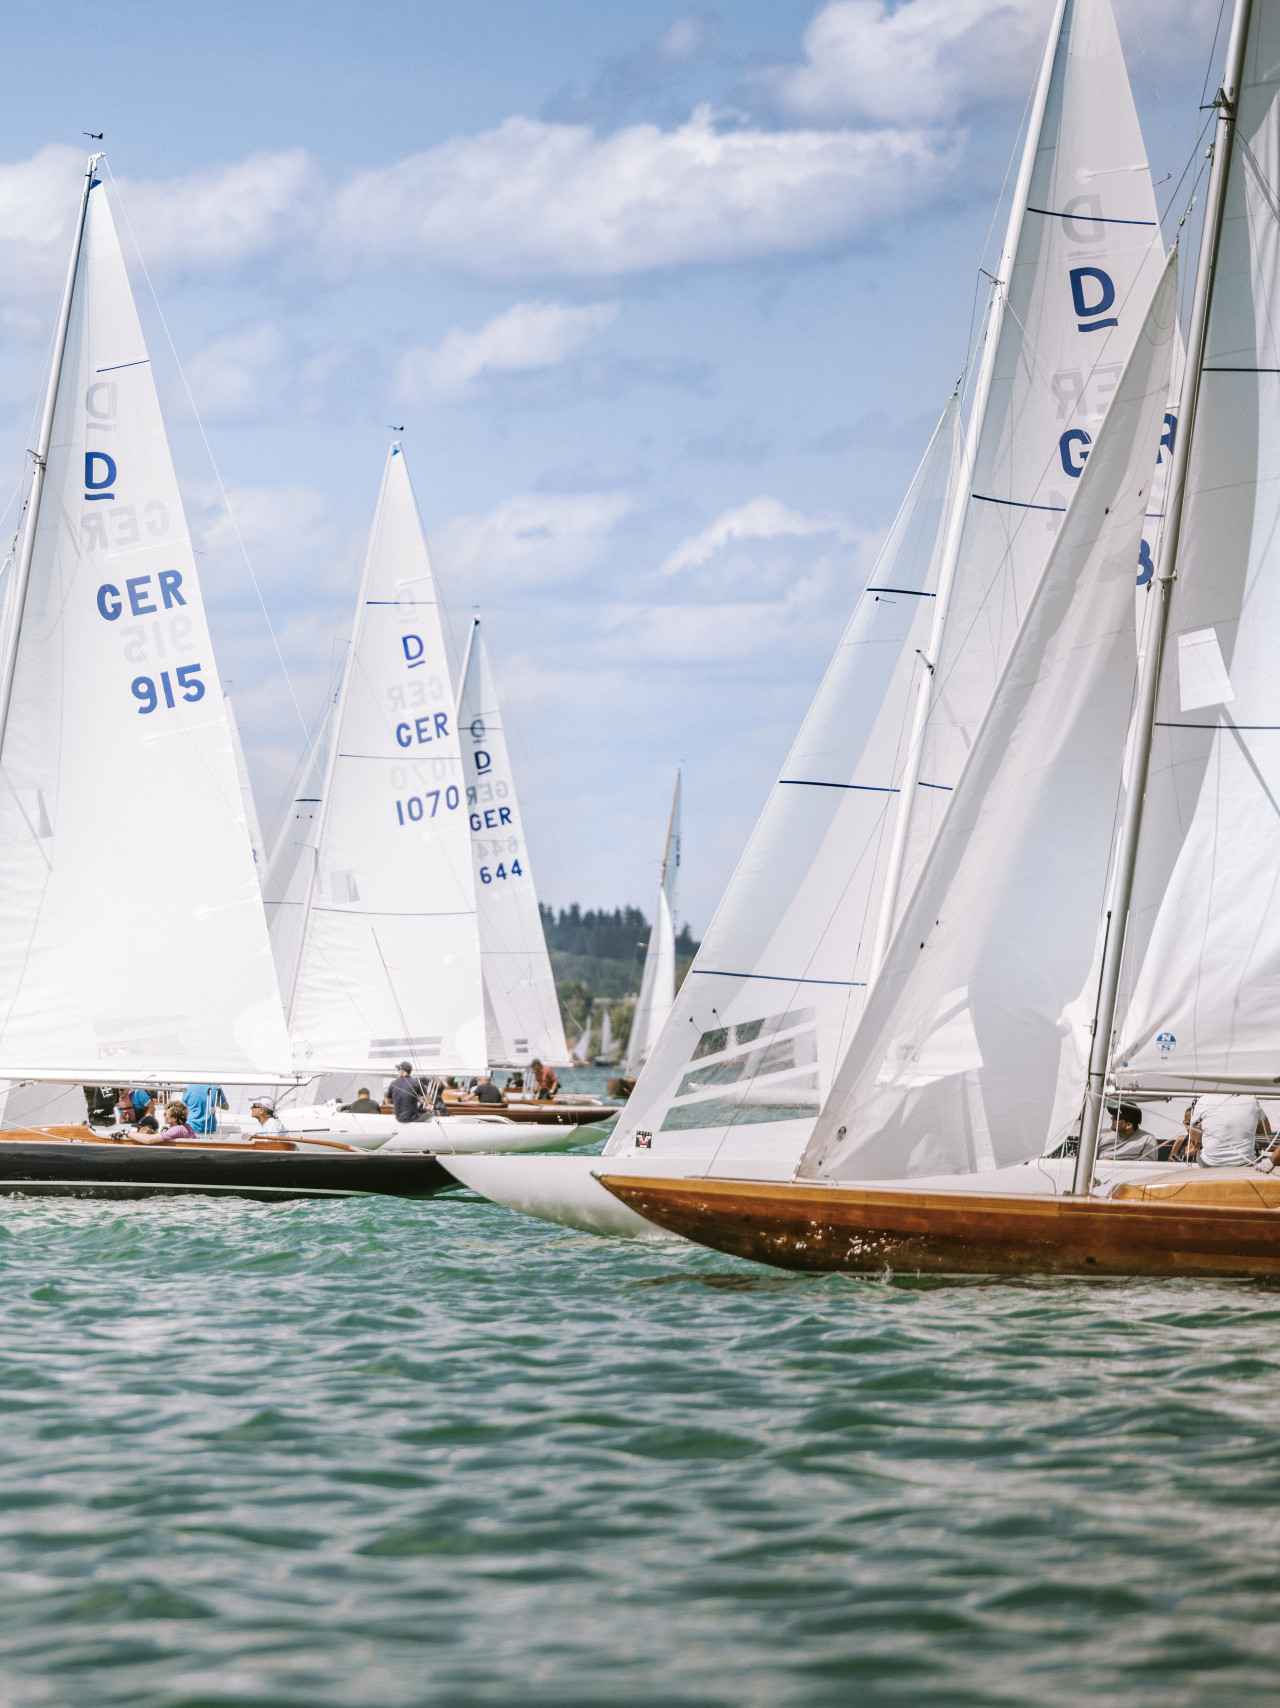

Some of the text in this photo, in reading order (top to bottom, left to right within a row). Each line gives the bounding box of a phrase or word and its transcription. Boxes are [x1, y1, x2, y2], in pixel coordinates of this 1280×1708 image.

[1069, 266, 1118, 333] D
[1059, 413, 1178, 478] GR
[84, 451, 117, 501] D
[97, 569, 187, 621] GER
[401, 634, 426, 669] D
[131, 663, 206, 714] 915
[396, 712, 450, 747] GER
[474, 750, 492, 776] D
[396, 785, 460, 826] 1070
[470, 807, 513, 831] GER
[479, 859, 523, 884] 644
